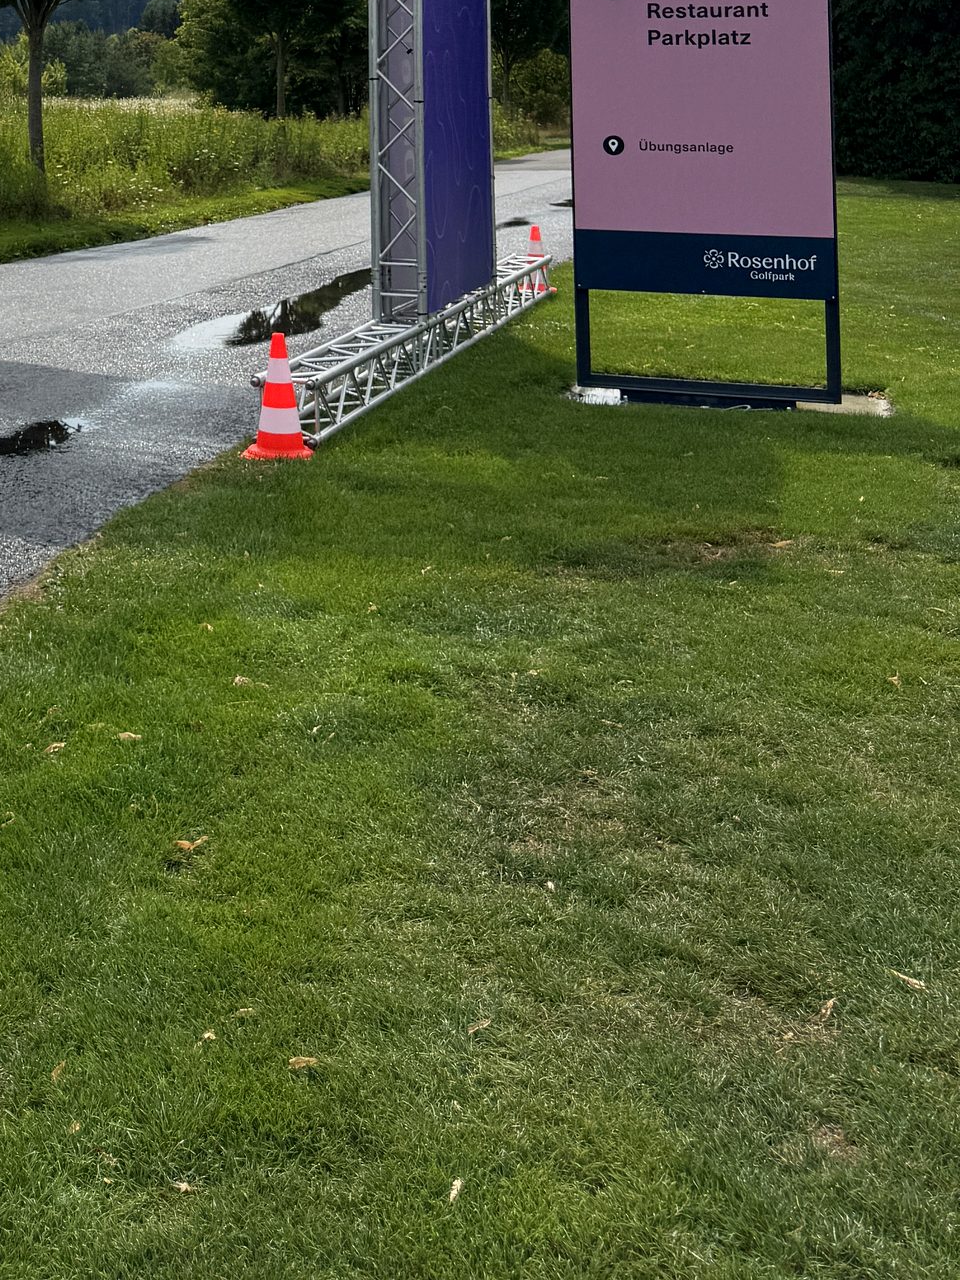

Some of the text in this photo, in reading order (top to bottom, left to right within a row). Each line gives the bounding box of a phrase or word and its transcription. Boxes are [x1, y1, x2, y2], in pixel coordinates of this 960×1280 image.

[647, 2, 769, 19] Restaurant
[647, 28, 752, 50] Parkplatz
[639, 139, 734, 155] Übungsanlage
[727, 251, 817, 271] Rosenhof
[750, 270, 795, 282] Golfpark
